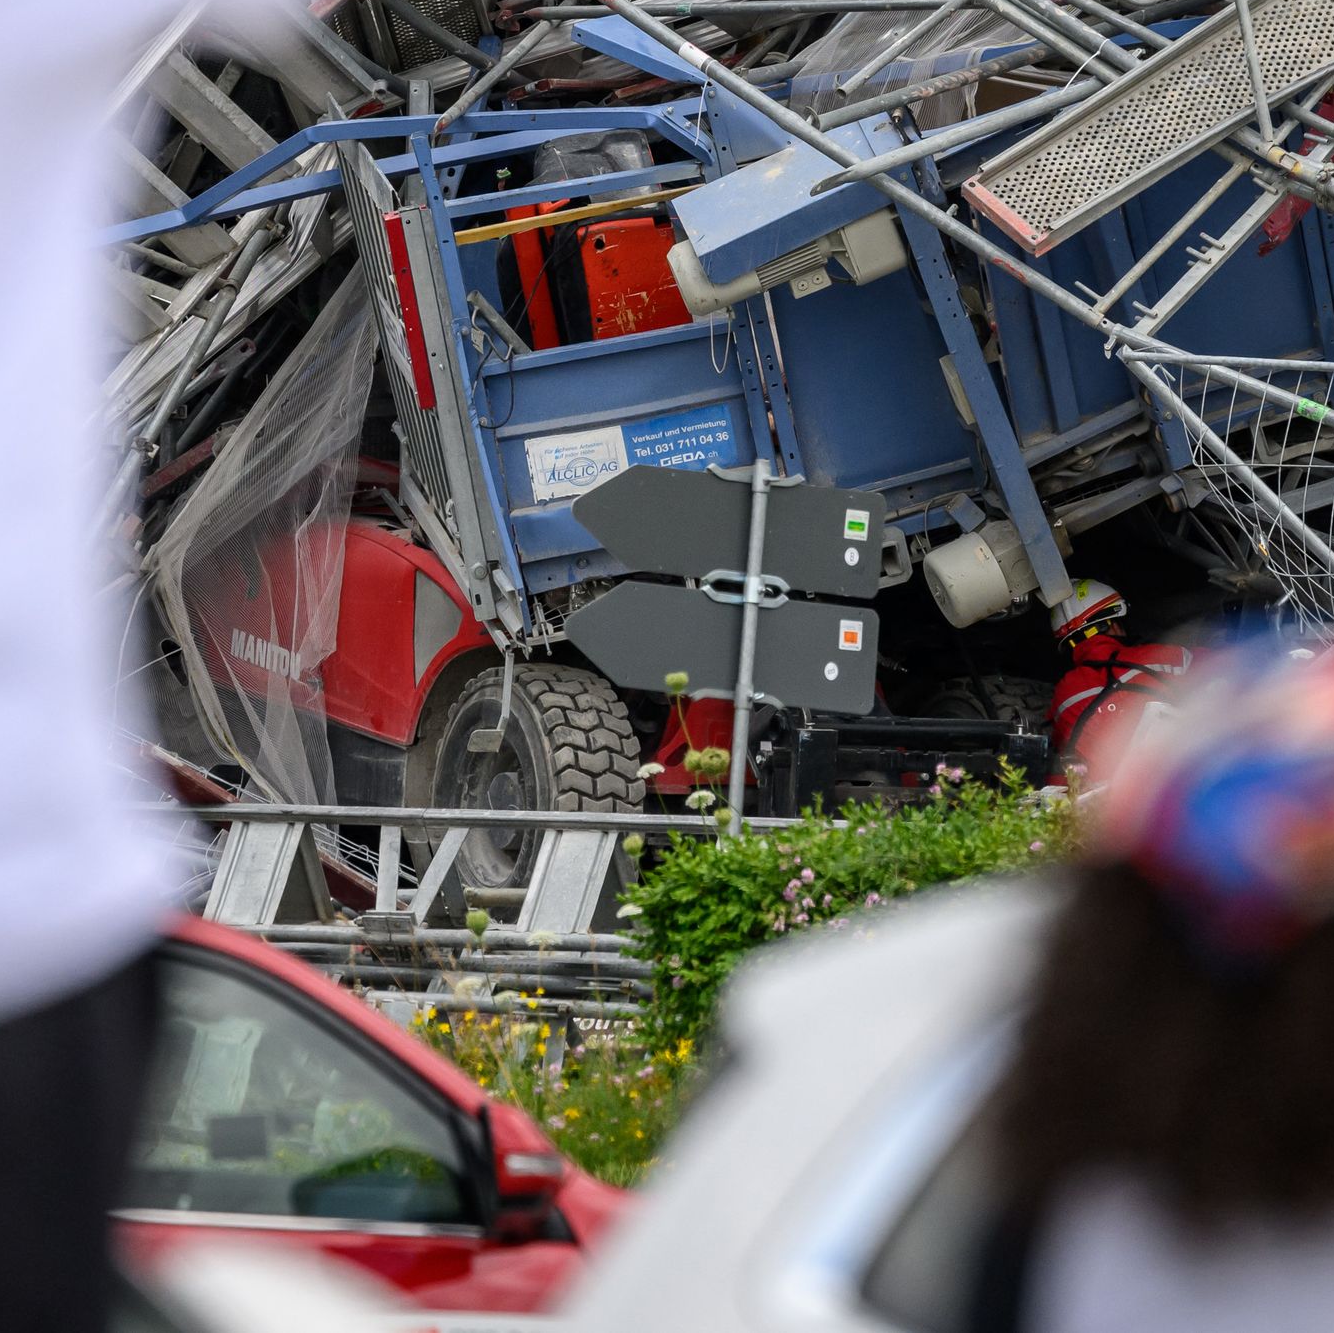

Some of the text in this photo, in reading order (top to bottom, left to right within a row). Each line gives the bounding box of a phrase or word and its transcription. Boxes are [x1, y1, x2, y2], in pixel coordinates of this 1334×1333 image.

[632, 419, 727, 443] Verkauf und Vermietung
[634, 431, 729, 457] Tel. 031 711 04 36
[548, 461, 619, 483] ALCLIC AG
[230, 627, 302, 681] MANITOU
